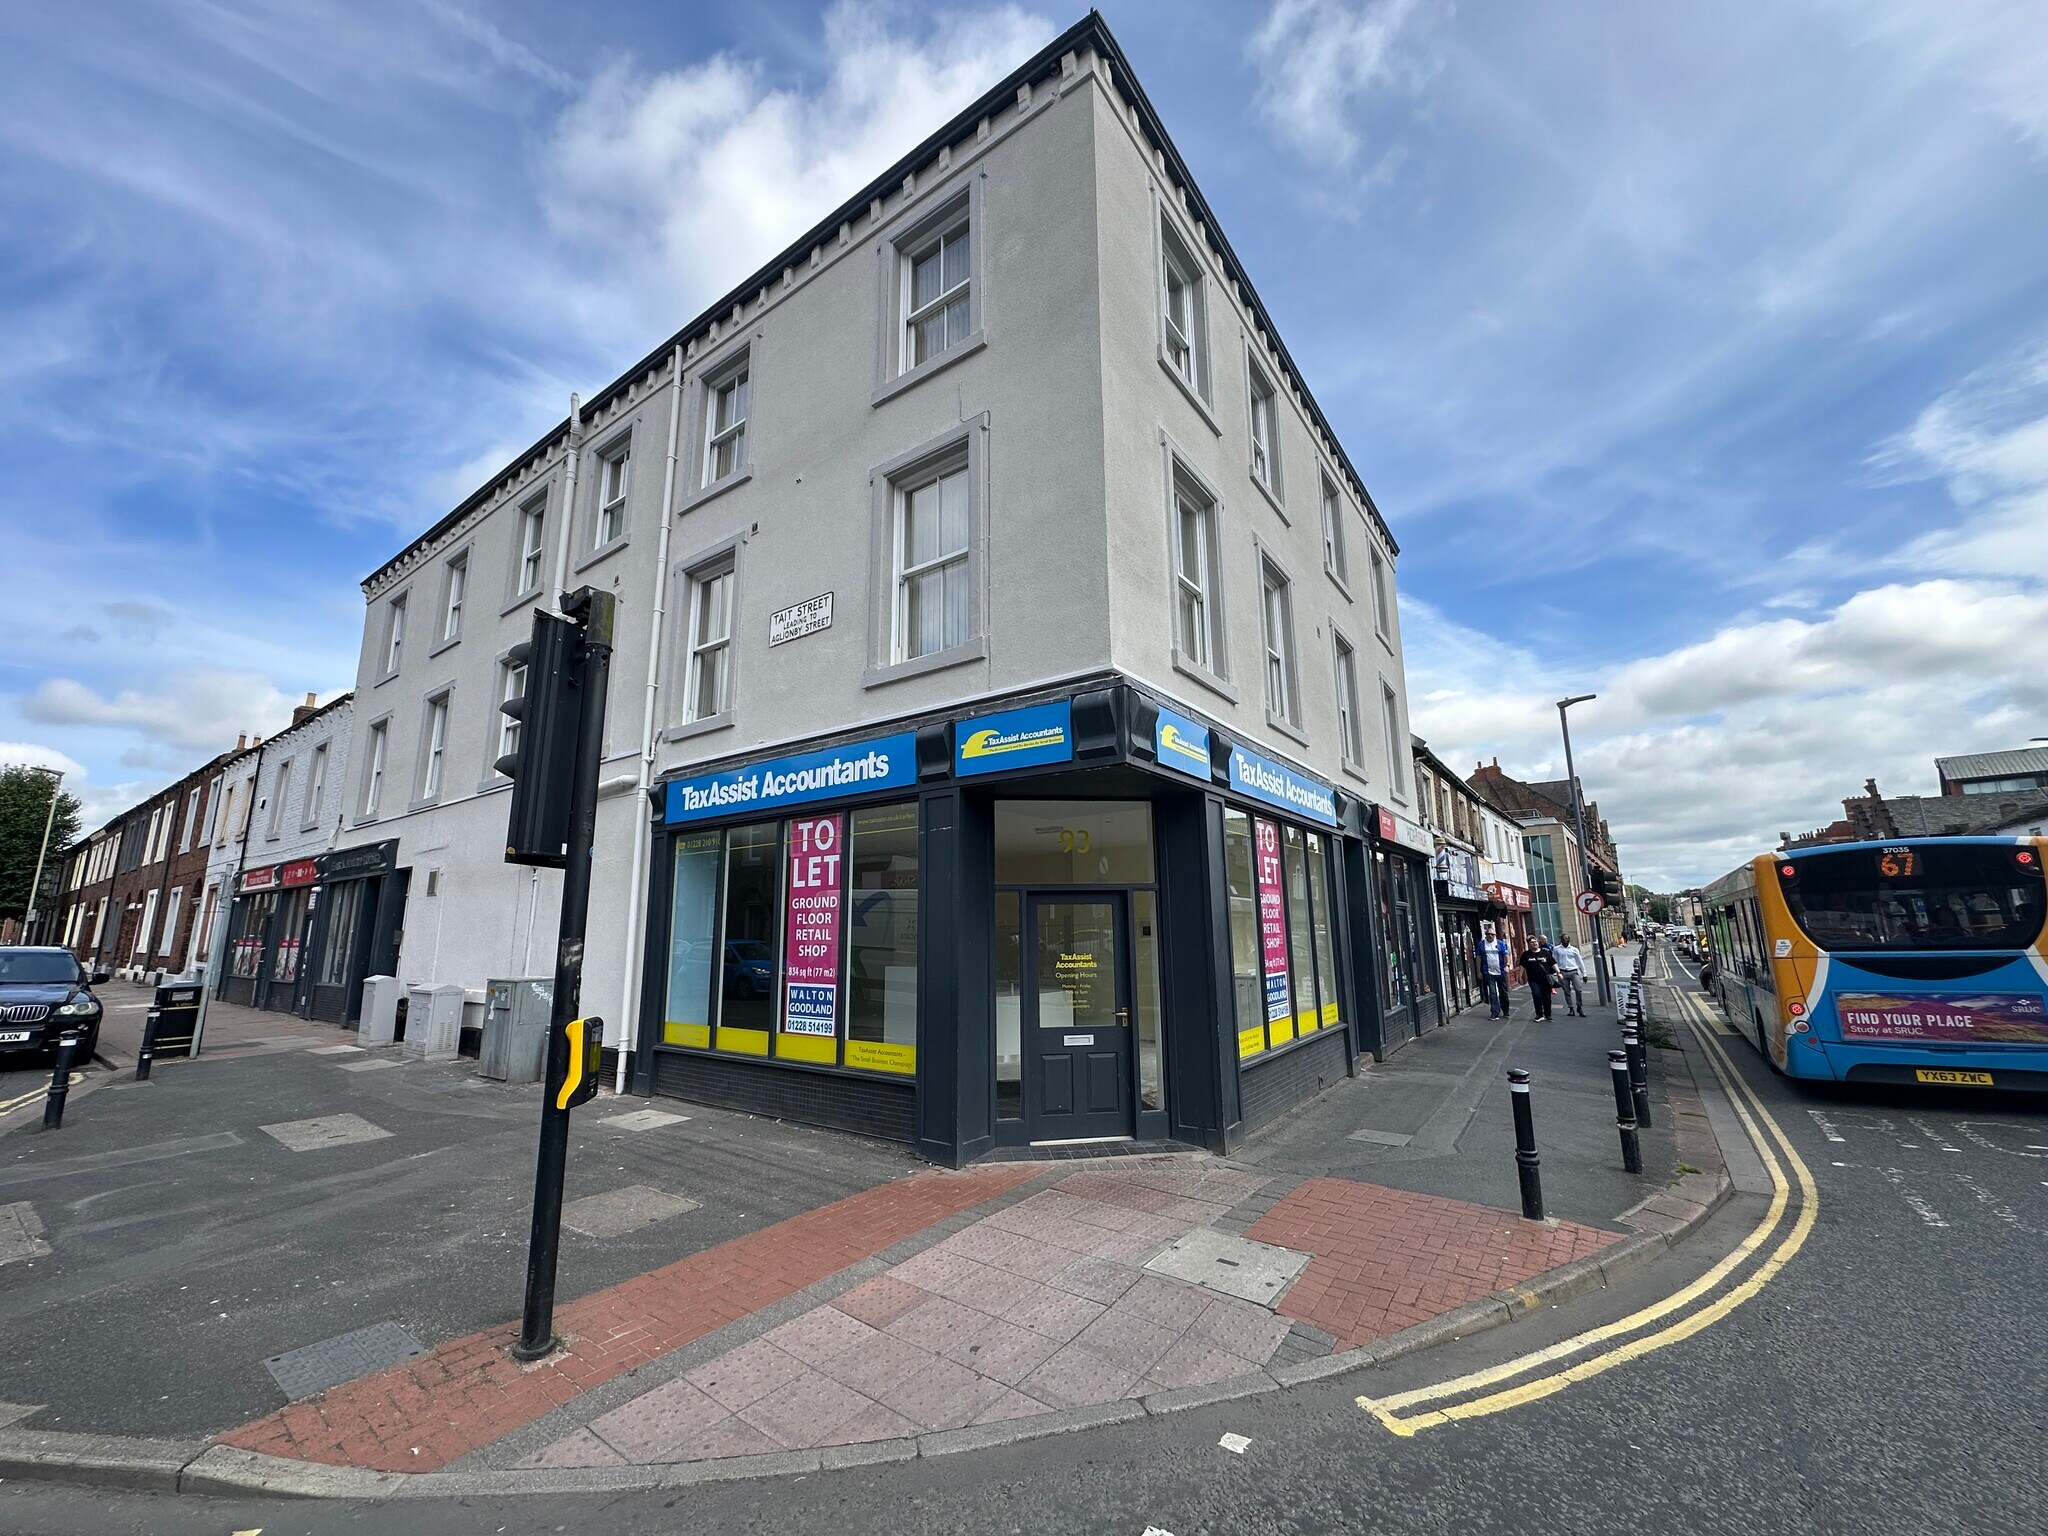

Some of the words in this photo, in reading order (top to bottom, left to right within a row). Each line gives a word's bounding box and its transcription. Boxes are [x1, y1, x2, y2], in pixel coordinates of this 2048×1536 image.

[774, 610, 793, 625] TAIT
[797, 596, 830, 617] STREET
[784, 616, 807, 630] LEADING
[810, 612, 817, 620] TO
[771, 626, 802, 644] AGLIONBY
[805, 616, 830, 632] STREET
[988, 733, 1019, 746] TaxAssist
[1020, 726, 1063, 740] Accountants
[682, 774, 758, 811] TaxAssist
[761, 750, 889, 799] Accountants
[1235, 752, 1284, 798] TaxAssist
[1286, 776, 1332, 817] Accountants
[798, 819, 835, 852] TO
[1060, 829, 1090, 854] 93
[1256, 822, 1275, 853] TO
[1881, 846, 1910, 854] 37035
[793, 854, 840, 888] LET
[1257, 855, 1279, 885] LET
[1881, 852, 1914, 877] 67
[792, 896, 838, 909] GROUND
[1260, 893, 1280, 905] GROUND
[796, 912, 832, 925] FLOOR
[1262, 908, 1280, 919] FLOOR
[795, 928, 832, 941] RETAIL
[1263, 922, 1281, 934] RETAIL
[1266, 937, 1280, 949] SHOP
[798, 945, 827, 957] SHOP
[1060, 953, 1093, 961] TaxAssist
[1055, 961, 1098, 969] Accountants
[788, 966, 799, 976] 834
[799, 968, 807, 978] sq
[807, 967, 812, 977] ft
[813, 967, 822, 978] (77
[823, 967, 835, 979] m2)
[1055, 972, 1079, 980] Opening
[1266, 977, 1286, 990] WALTON
[790, 989, 833, 1001] WALTON
[1267, 989, 1287, 1002] GOODLAND
[789, 1002, 833, 1015] GOODLAND
[2011, 1005, 2041, 1014] SRUC
[787, 1019, 807, 1032] 01228
[808, 1021, 833, 1034] 514199
[1847, 1012, 1880, 1025] FIND
[1883, 1013, 1922, 1027] YOUR
[1927, 1014, 1975, 1028] PLACE
[1850, 1025, 1880, 1035] Study
[1882, 1026, 1893, 1034] at
[1894, 1026, 1924, 1035] SRUC
[0, 1033, 21, 1041] AXN
[858, 1046, 877, 1055] TaxAssist
[877, 1049, 903, 1057] Accountants
[1921, 1071, 1957, 1082] YX63
[1959, 1073, 1987, 1084] ZWC
